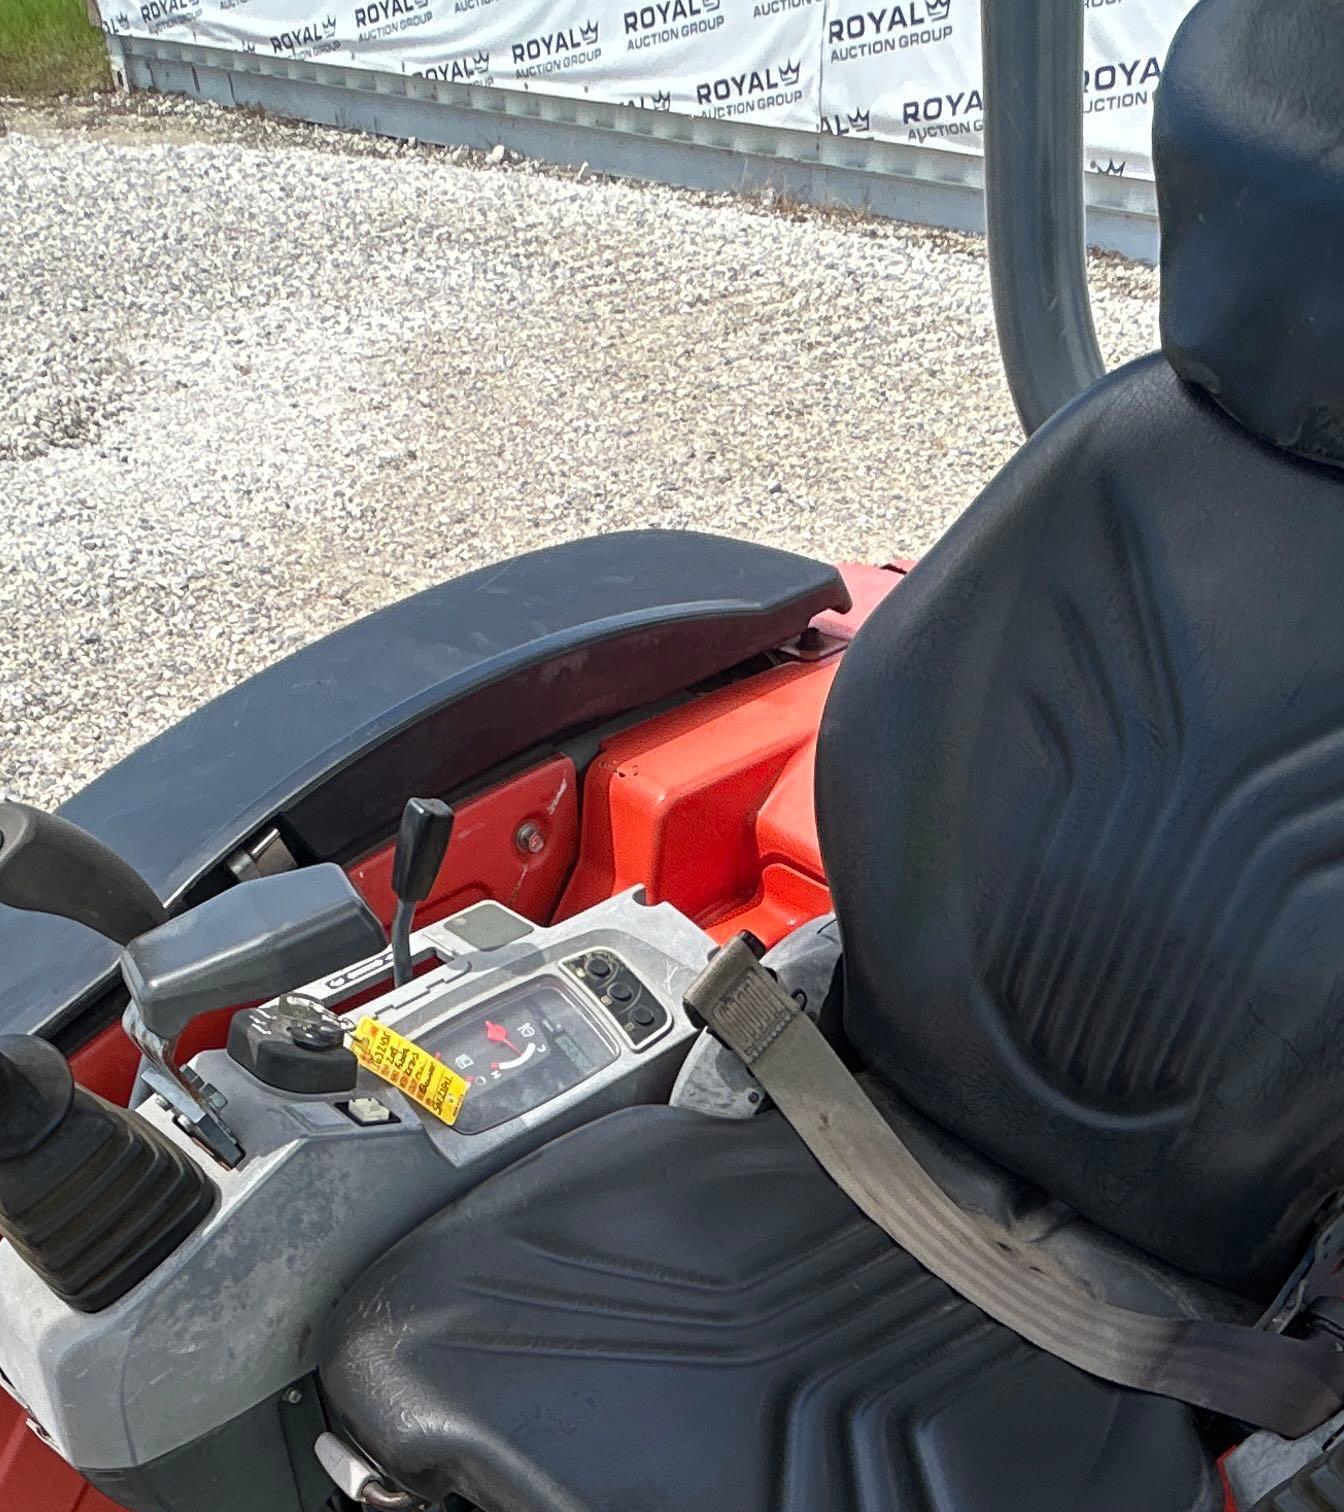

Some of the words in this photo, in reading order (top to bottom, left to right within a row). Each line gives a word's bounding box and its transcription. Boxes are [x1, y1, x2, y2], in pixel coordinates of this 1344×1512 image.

[358, 22, 398, 43] AUCTION
[400, 11, 433, 31] GROUP
[624, 0, 701, 34] ROYAL
[627, 27, 679, 51] AUCTION
[681, 15, 725, 37] GROUP
[829, 2, 924, 44] ROYAL
[270, 23, 323, 53] ROYAL
[512, 29, 581, 64] ROYAL
[830, 39, 895, 63] AUCTION
[899, 25, 953, 48] GROUP
[515, 59, 561, 79] AUCTION
[563, 48, 602, 68] GROUP
[697, 68, 779, 104] ROYAL
[757, 90, 803, 110] GROUP
[1083, 91, 1147, 113] UCTION
[903, 90, 983, 124] ROYA
[908, 122, 971, 141] AUCTION
